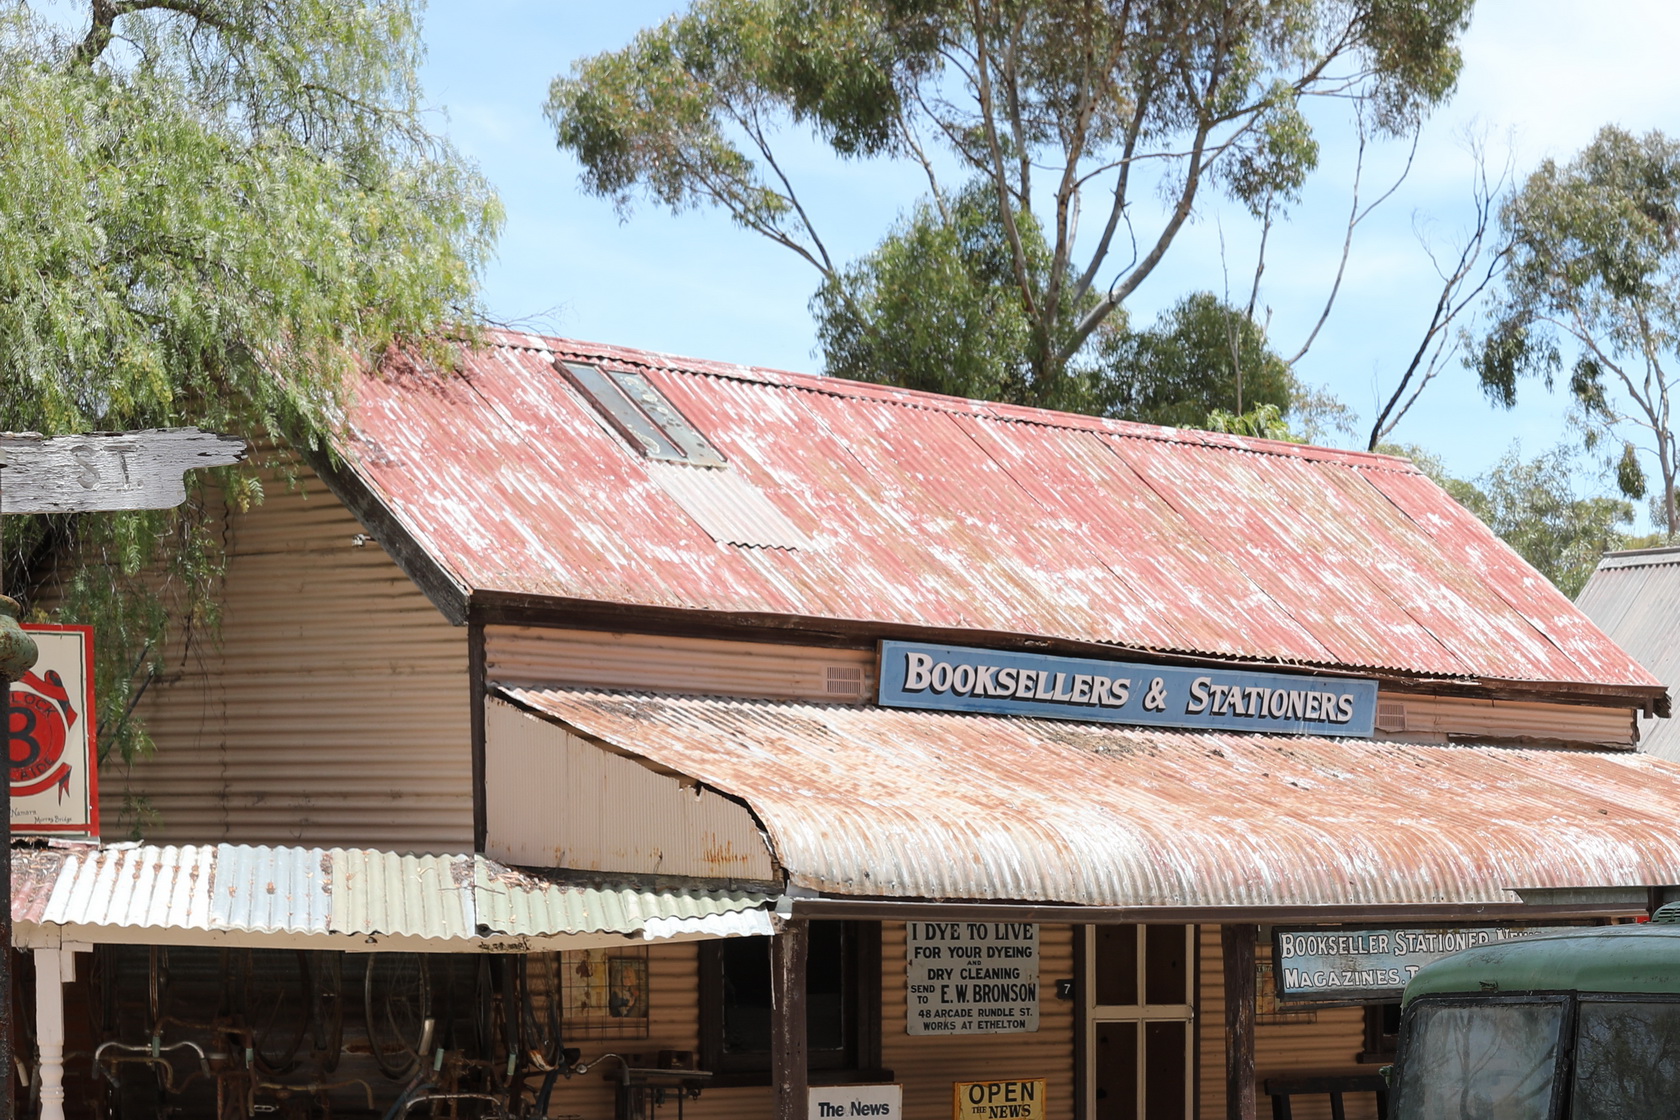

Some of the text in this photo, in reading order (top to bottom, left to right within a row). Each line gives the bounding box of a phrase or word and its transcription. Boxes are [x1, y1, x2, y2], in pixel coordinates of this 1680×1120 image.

[903, 651, 1355, 724] BOOKSELLERS & STATIONERS
[912, 923, 1034, 941] I DYE TO LIVE
[914, 946, 1033, 959] FOR YOUR DYEING
[1281, 933, 1389, 959] BOOKSELLER
[927, 968, 1020, 980] DRY CLEANING
[1284, 968, 1405, 988] MAGAZINES.
[911, 984, 935, 994] SEND
[973, 983, 1036, 1003] BRONSON
[1063, 983, 1071, 994] 7
[917, 995, 929, 1004] TO
[918, 1007, 1033, 1018] 48 ARCADE RUNDLE ST.
[923, 1020, 1026, 1031] WORKS AT ETHELTON
[968, 1081, 1034, 1105] OPEN
[818, 1101, 890, 1118] The News
[972, 1104, 1031, 1119] THE NEWS
